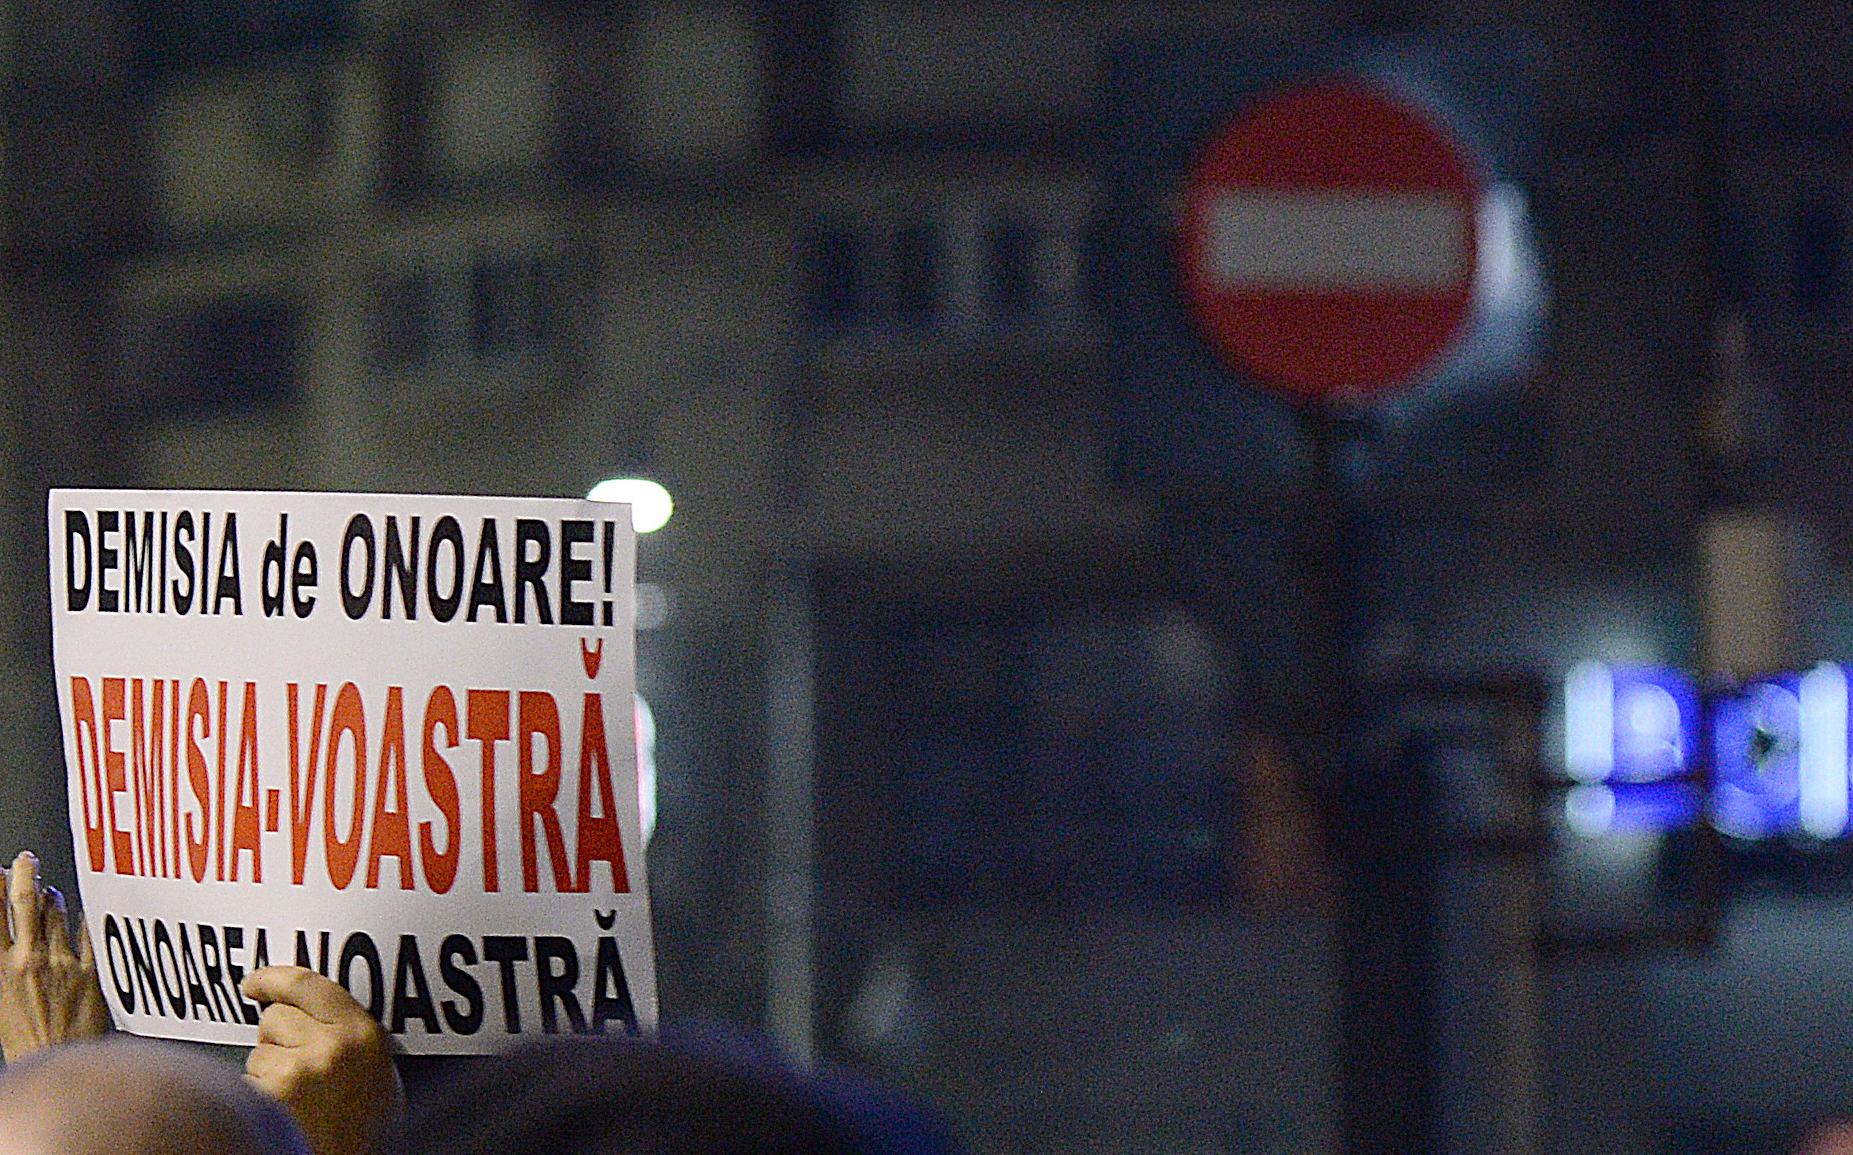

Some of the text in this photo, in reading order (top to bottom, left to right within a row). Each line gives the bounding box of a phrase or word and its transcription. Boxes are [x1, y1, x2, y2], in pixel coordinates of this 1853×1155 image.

[65, 509, 616, 627] DEMISIA de ONOARE!
[70, 637, 631, 895] DEMISIA-VOASTRĂ
